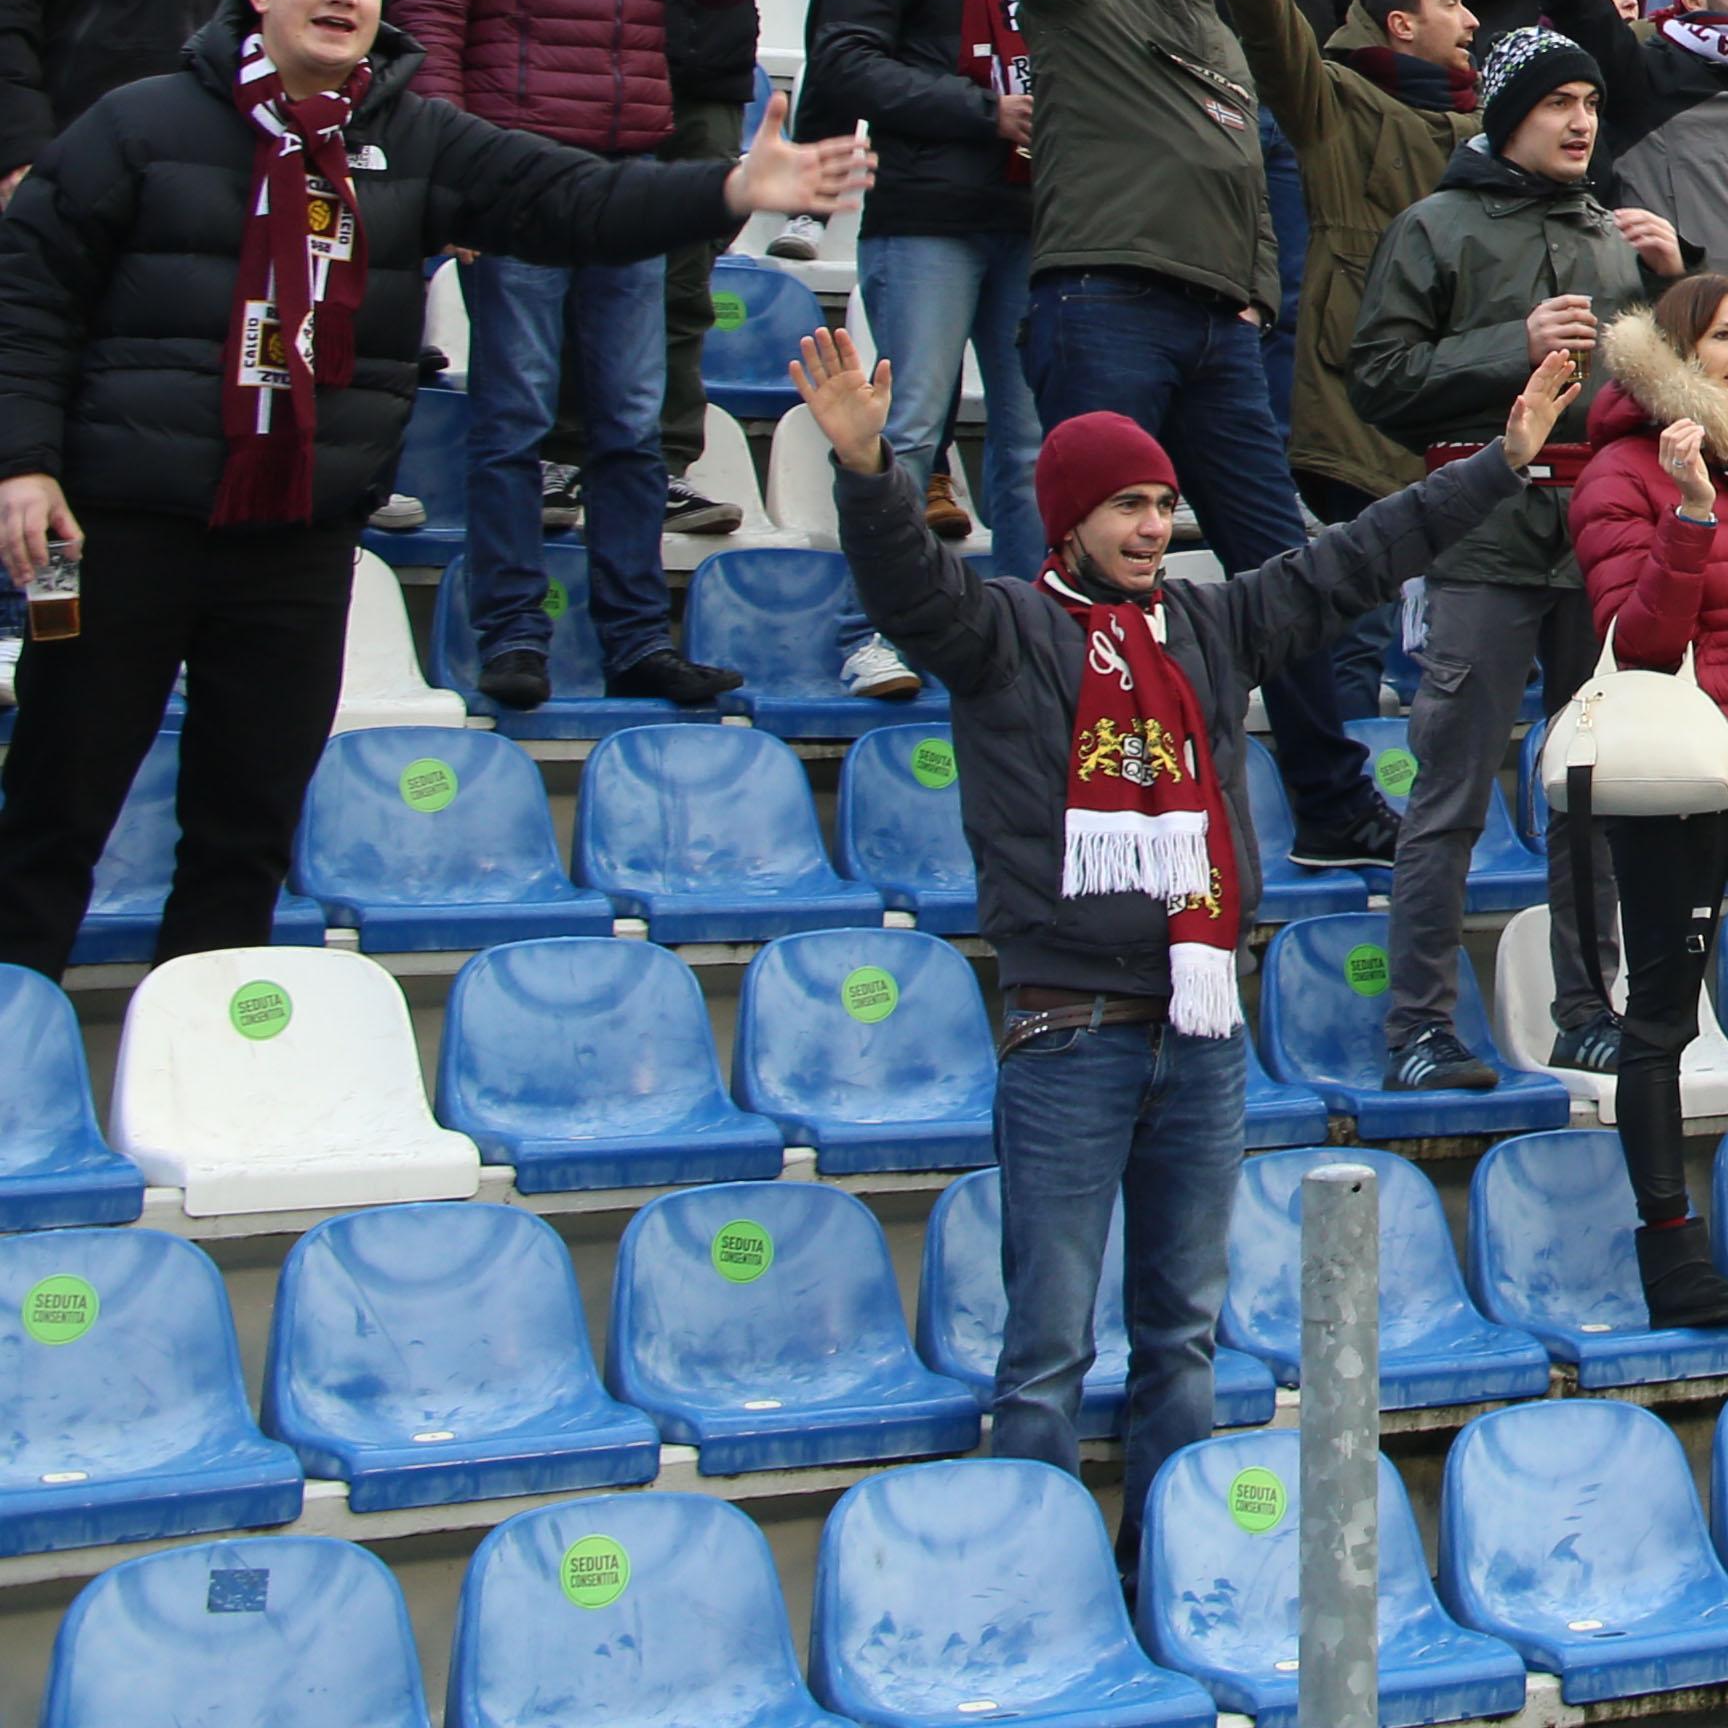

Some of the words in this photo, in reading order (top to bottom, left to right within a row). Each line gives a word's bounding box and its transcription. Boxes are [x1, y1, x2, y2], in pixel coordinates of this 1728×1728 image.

[244, 316, 259, 369] CALCIO
[919, 749, 952, 767] SEDUTA
[407, 769, 446, 790] SEDUTA
[1350, 957, 1385, 972] SEDUTA
[849, 979, 887, 998] SEDUTA
[237, 993, 281, 1014] SEDUTA
[851, 993, 891, 1010] CONSENTITA
[240, 1007, 286, 1026] CONSENTITA
[721, 1235, 764, 1253] SEDUTA
[719, 1250, 762, 1267] CONSENTITA
[33, 1293, 88, 1310] SEDUTA
[33, 1308, 86, 1325] CONSENTITA
[1236, 1484, 1277, 1502] SEDUTA
[1235, 1500, 1277, 1516] CONSENTITA
[570, 1554, 619, 1573] SEDUTA
[570, 1571, 619, 1589] CONSENTITA
